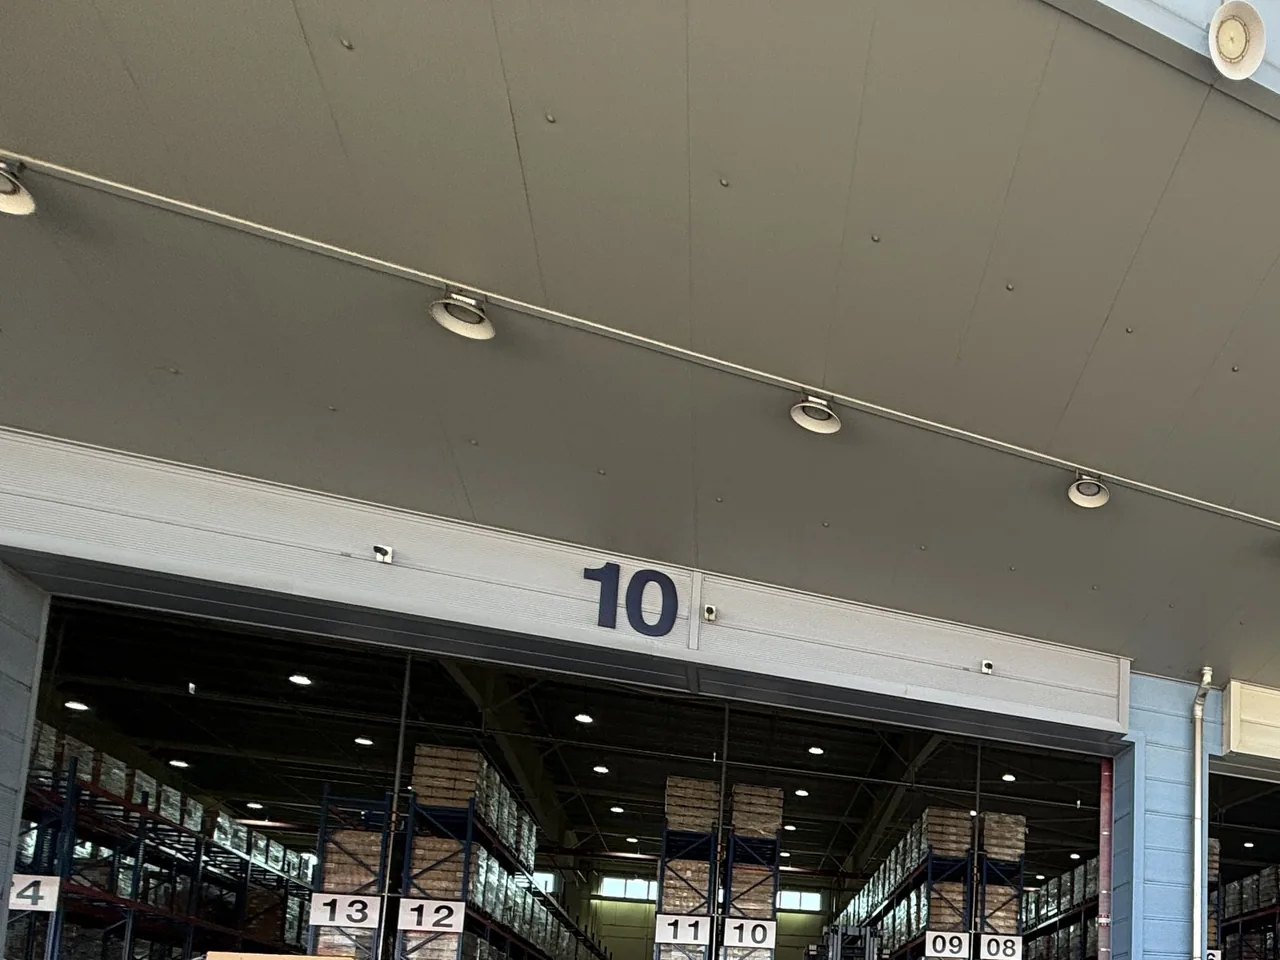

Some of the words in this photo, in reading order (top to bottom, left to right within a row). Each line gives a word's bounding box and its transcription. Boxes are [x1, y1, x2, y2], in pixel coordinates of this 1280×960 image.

[583, 562, 679, 637] 10
[11, 879, 45, 906] 4
[322, 898, 369, 923] 13
[410, 903, 455, 928] 12
[667, 919, 700, 941] 11
[733, 923, 768, 944] 10
[932, 934, 963, 954] 09
[986, 938, 1016, 957] 08
